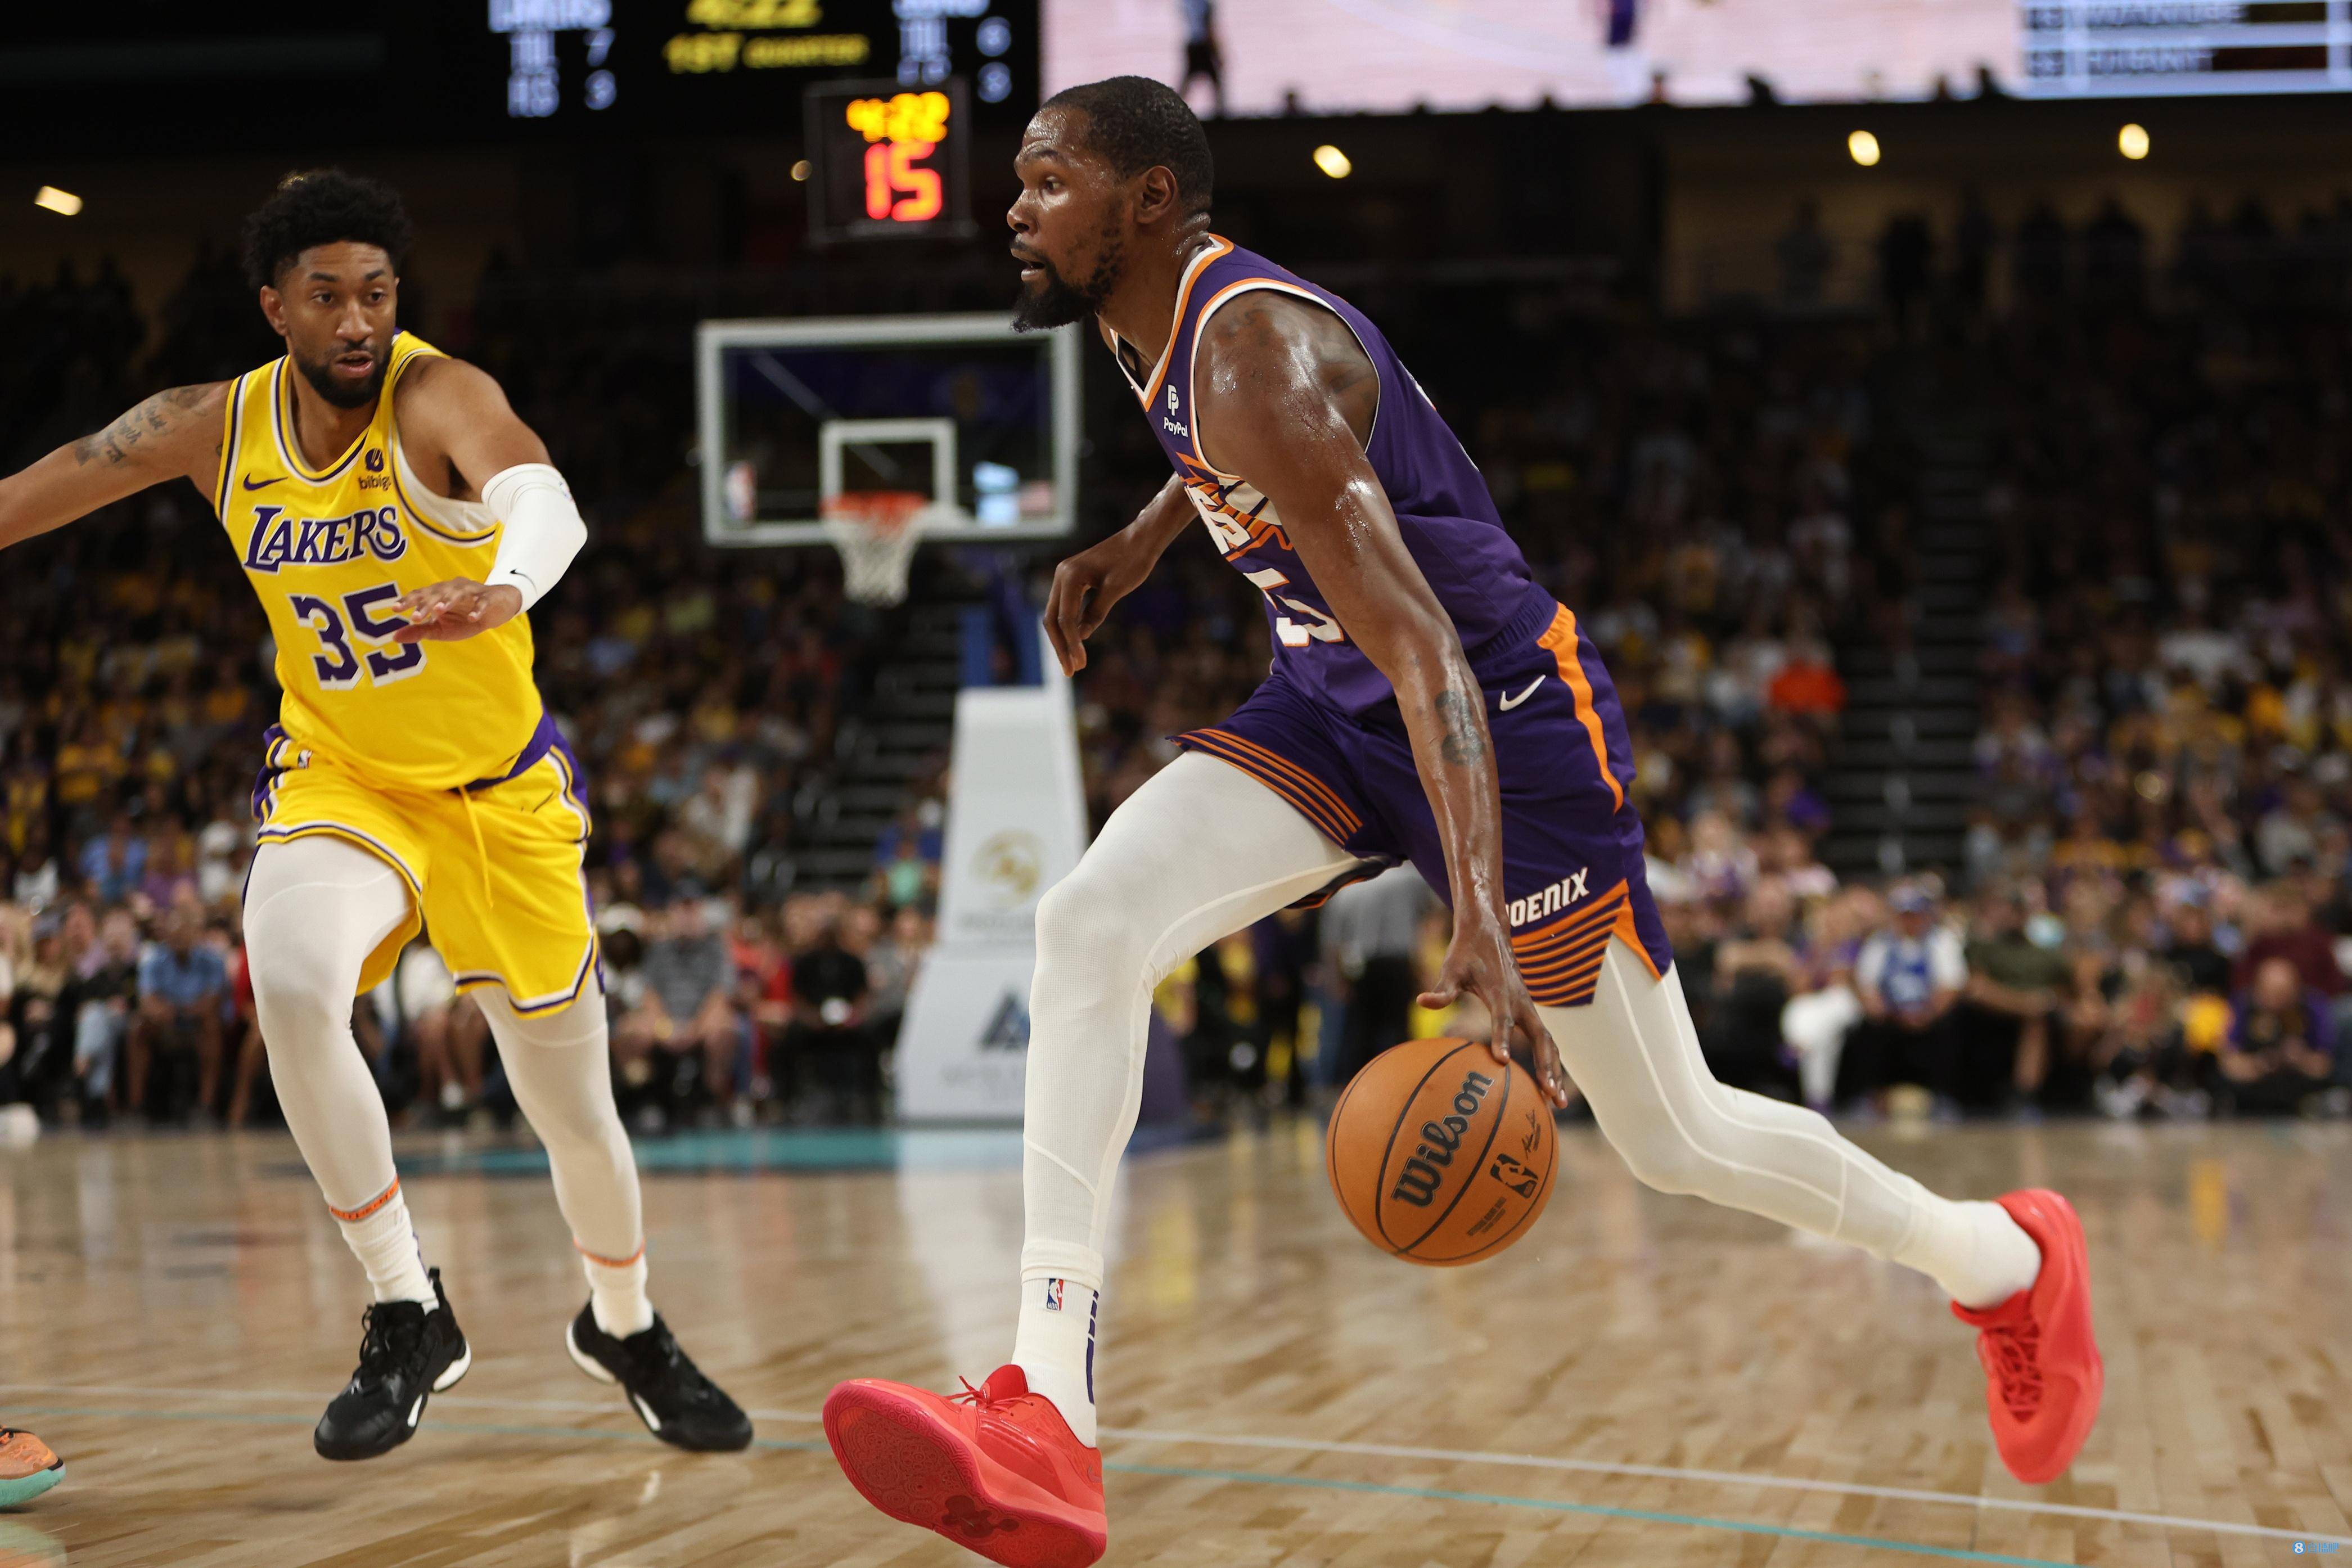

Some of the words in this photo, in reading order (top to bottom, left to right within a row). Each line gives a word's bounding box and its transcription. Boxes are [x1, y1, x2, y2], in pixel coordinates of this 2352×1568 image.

[864, 141, 943, 222] 15
[1164, 416, 1188, 438] PayPal
[358, 474, 391, 491] bibig
[243, 504, 408, 575] LAKERS
[286, 581, 427, 691] 35
[1505, 866, 1590, 927] OENIX
[1390, 1070, 1496, 1208] Wilson
